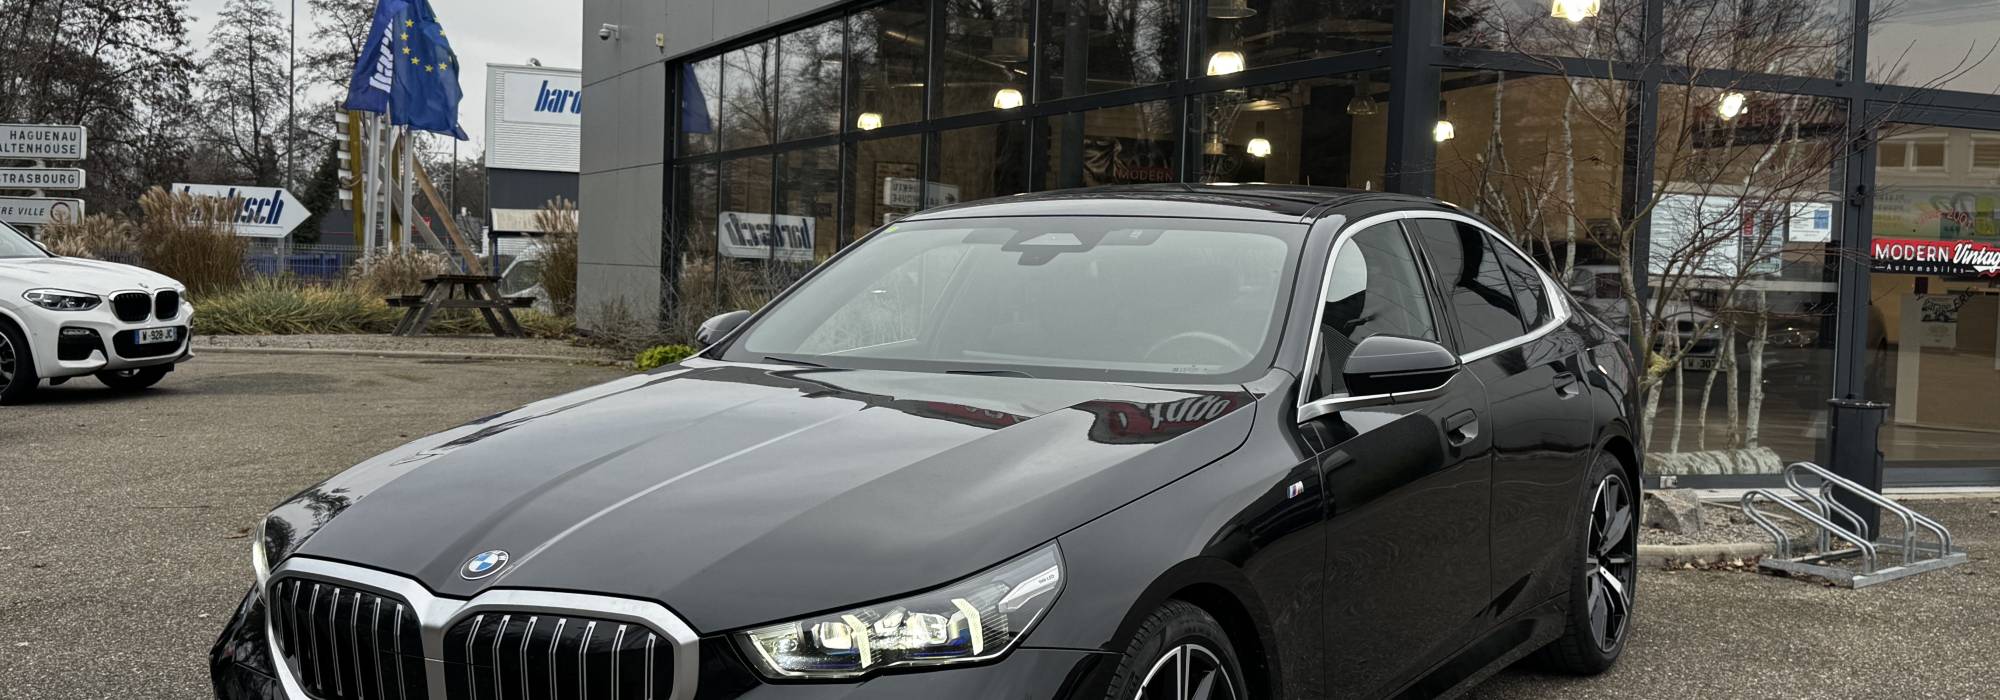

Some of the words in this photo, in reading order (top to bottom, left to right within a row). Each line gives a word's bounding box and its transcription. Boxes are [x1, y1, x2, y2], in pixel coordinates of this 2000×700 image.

[9, 130, 77, 142] HAGUENAU
[0, 173, 76, 184] TRASBOURG
[18, 207, 45, 217] VILLE
[1875, 243, 1949, 262] MODERN
[1886, 264, 1964, 274] Automobiles
